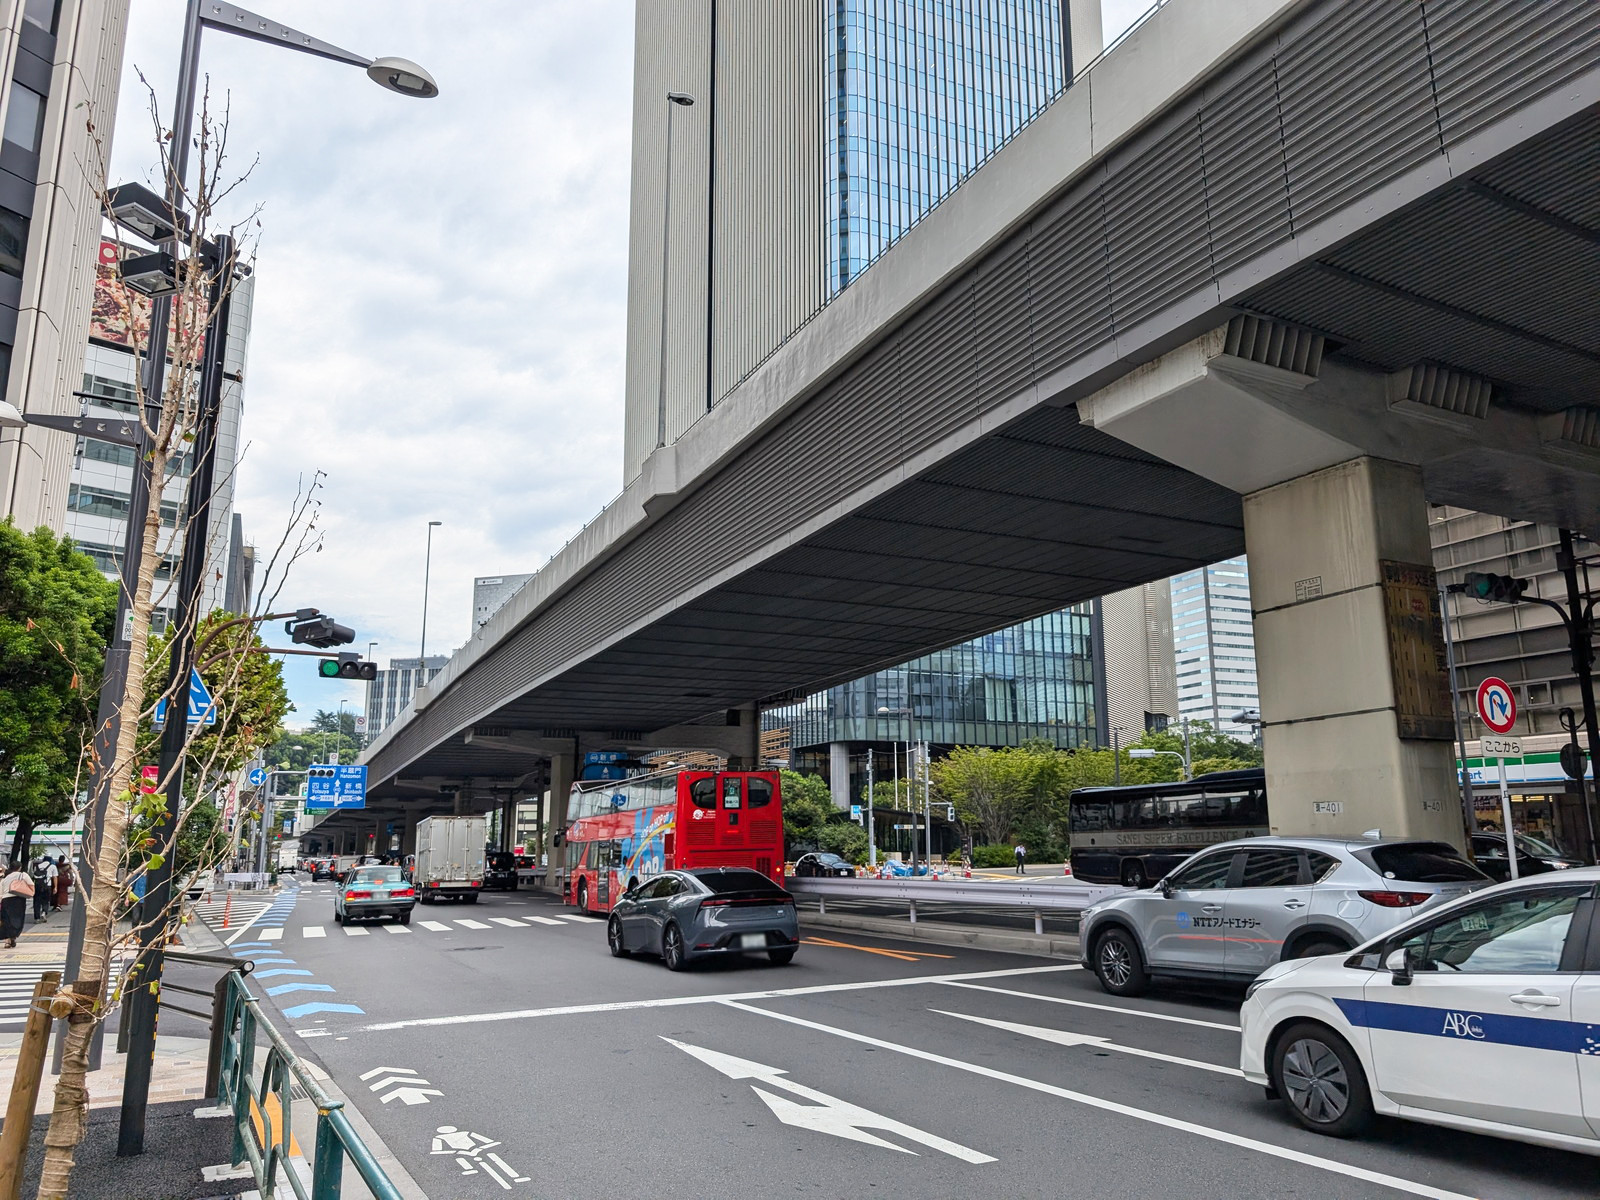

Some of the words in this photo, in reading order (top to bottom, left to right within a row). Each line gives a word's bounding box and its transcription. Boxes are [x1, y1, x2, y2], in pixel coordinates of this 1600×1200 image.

[1485, 741, 1520, 754] ここから
[1116, 834, 1141, 845] SANEI
[1192, 917, 1261, 929] NTTアノードエナジー
[1441, 1012, 1485, 1039] ABC
